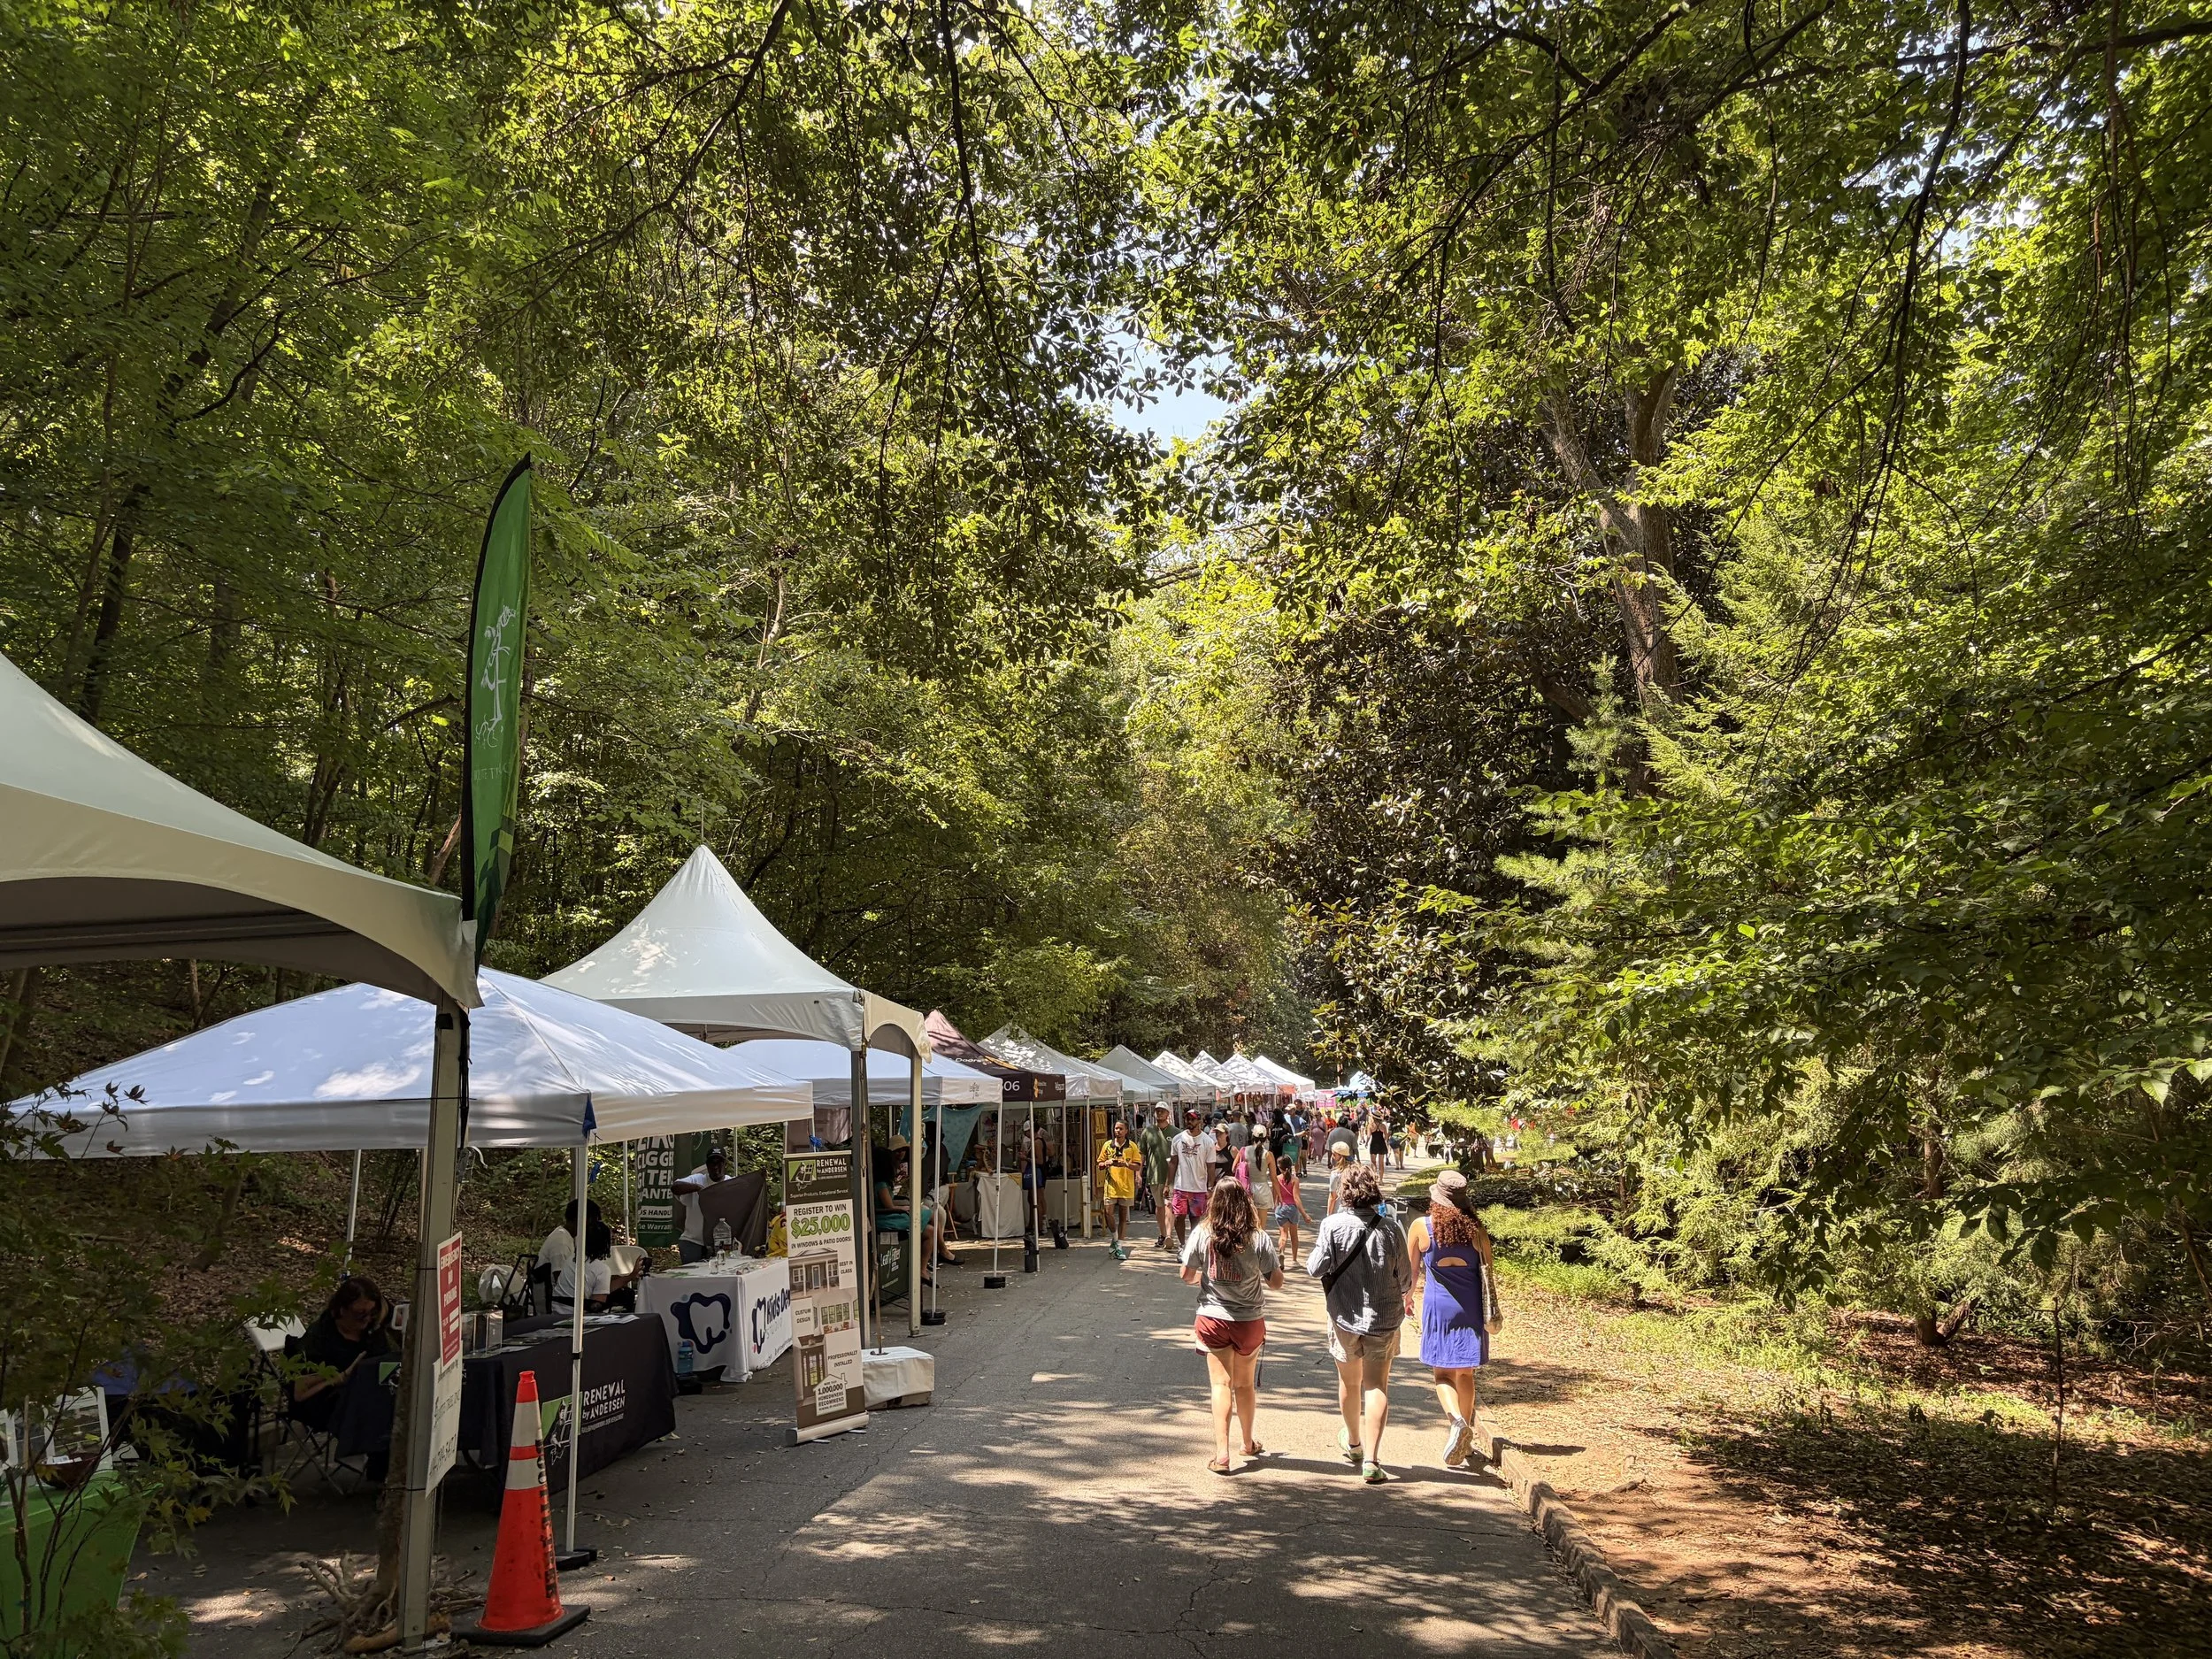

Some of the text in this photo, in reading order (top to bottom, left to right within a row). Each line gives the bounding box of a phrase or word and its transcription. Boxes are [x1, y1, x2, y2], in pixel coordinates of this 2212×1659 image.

[1002, 1080, 1020, 1092] 06
[816, 1157, 847, 1167] RENEWAL
[794, 1206, 824, 1216] REGISTER
[790, 1213, 850, 1239] $25,000
[766, 1293, 780, 1325] Kids
[827, 1350, 858, 1361] PROFESSIONALLY
[583, 1379, 626, 1406] RENEWAL
[818, 1383, 843, 1395] 1,000,000
[818, 1391, 844, 1401] HOMEOWNERS
[818, 1396, 844, 1407] RECOMMEND
[582, 1395, 626, 1420] by ANDERSEN
